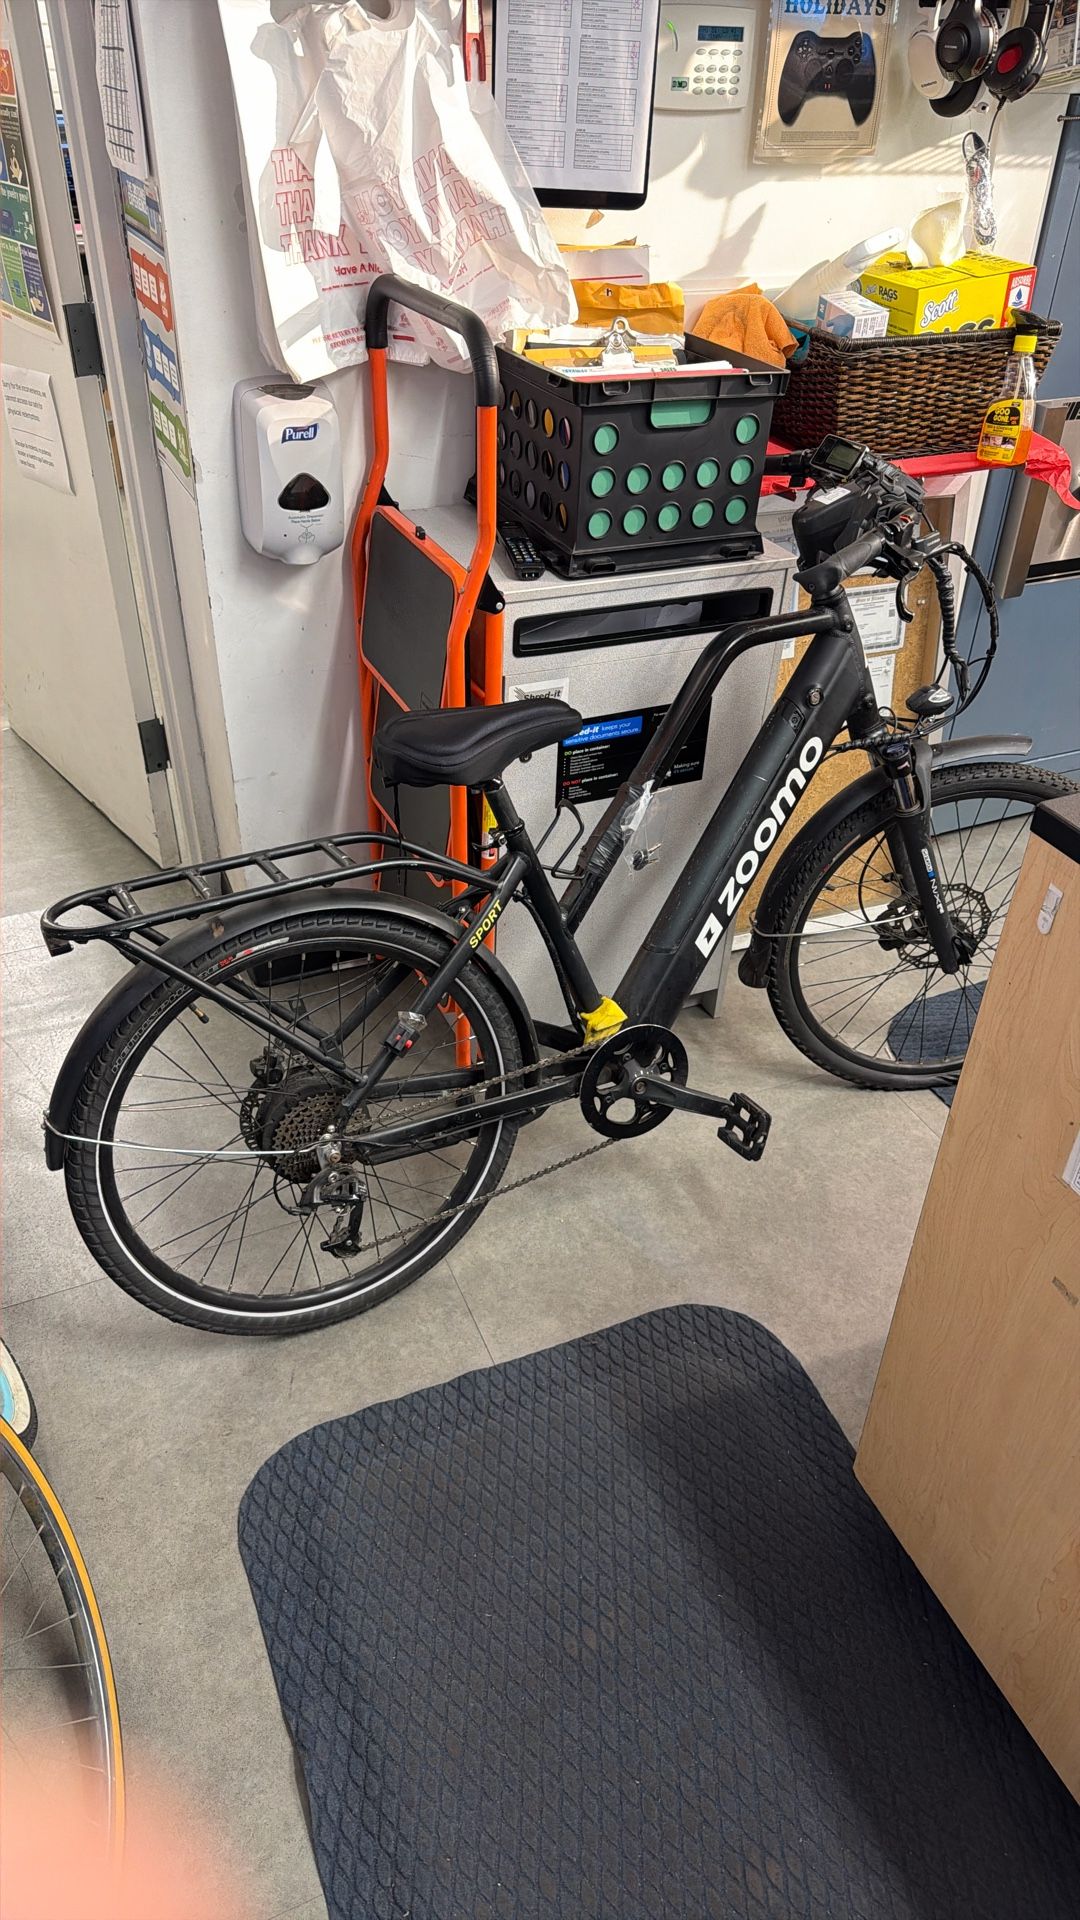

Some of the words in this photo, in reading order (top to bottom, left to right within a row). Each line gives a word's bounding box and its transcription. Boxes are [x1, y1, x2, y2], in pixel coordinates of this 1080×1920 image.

[784, 0, 886, 16] HOLIDAYS
[271, 148, 314, 184] THA
[275, 189, 315, 226] THA
[879, 286, 898, 301] RAGS
[920, 288, 959, 328] Scott
[995, 408, 1011, 416] GOO
[286, 428, 315, 440] Purell
[565, 737, 589, 745] sensitive
[589, 732, 620, 741] documents
[718, 736, 823, 917] zoomo
[469, 899, 502, 949] SPORT
